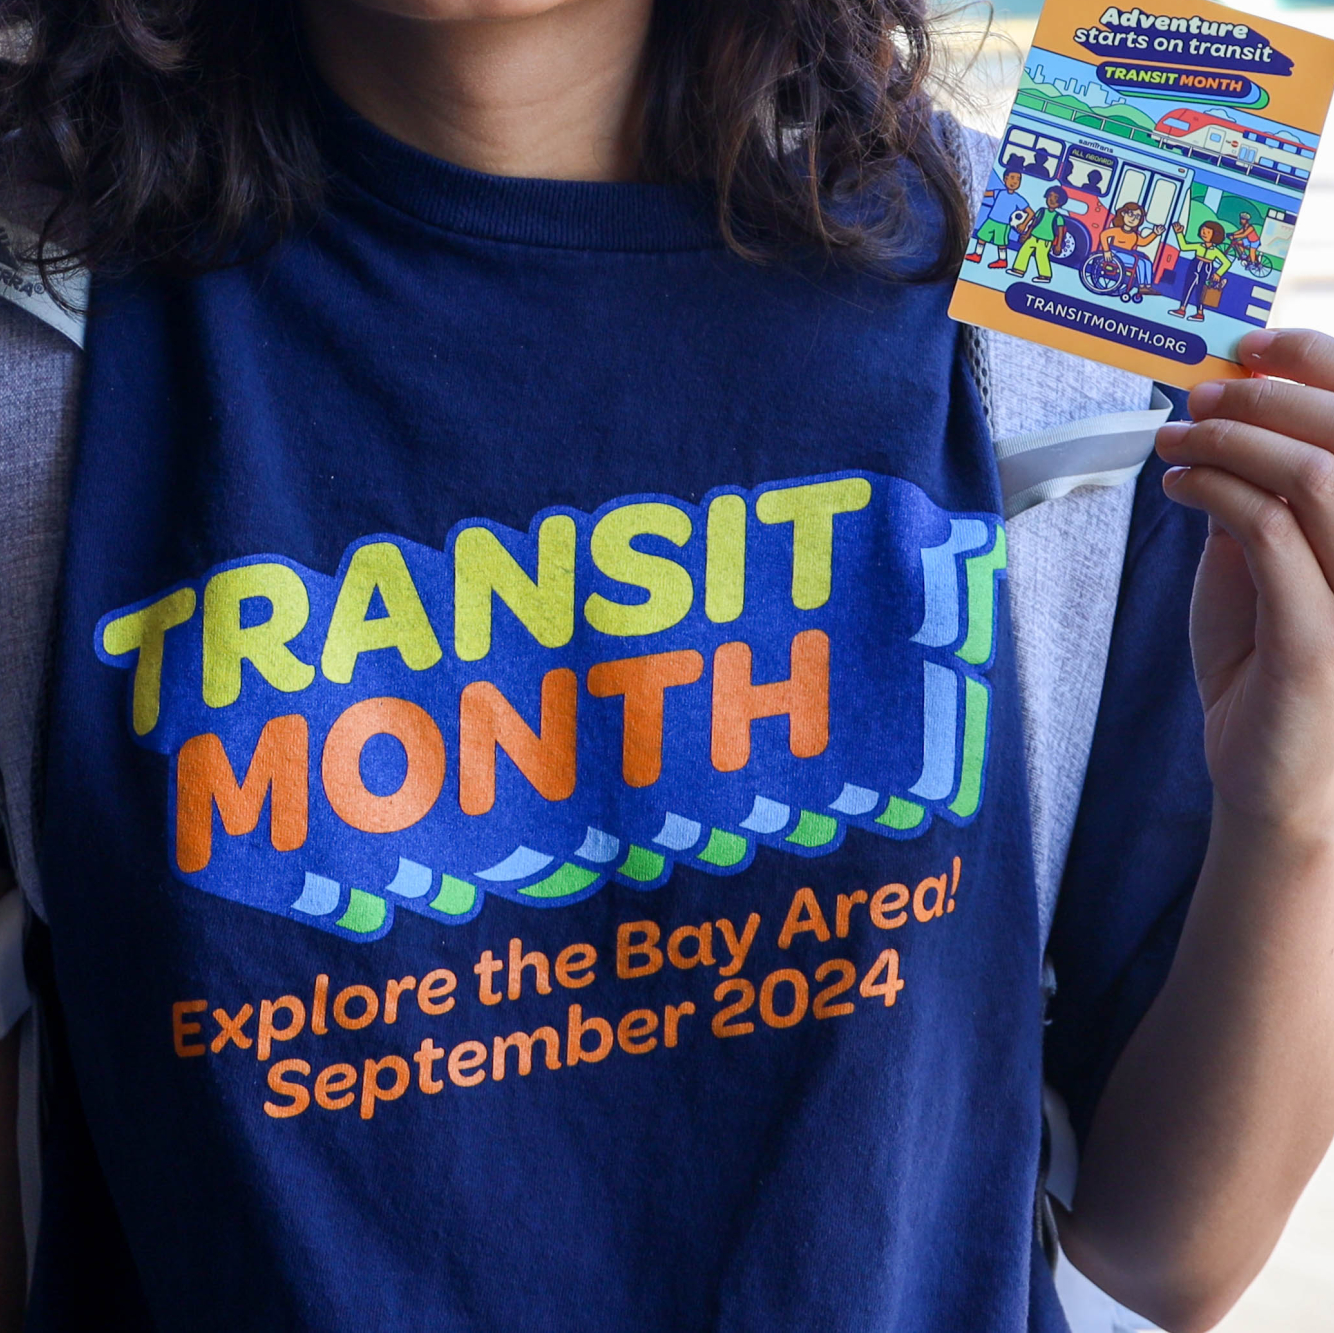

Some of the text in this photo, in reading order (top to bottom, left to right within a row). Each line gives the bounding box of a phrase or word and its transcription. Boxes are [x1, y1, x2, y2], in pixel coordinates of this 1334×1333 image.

[1074, 27, 1273, 62] starts on transit
[1100, 7, 1249, 39] Adventure
[1104, 66, 1243, 91] TRANSIT MONTH
[1025, 294, 1188, 354] TRANSITMONTH.ORG
[102, 477, 871, 736] TRANSIT
[175, 629, 830, 873] MONTH
[172, 857, 962, 1061] Explore the Bay Area!
[263, 948, 905, 1120] September 2024
